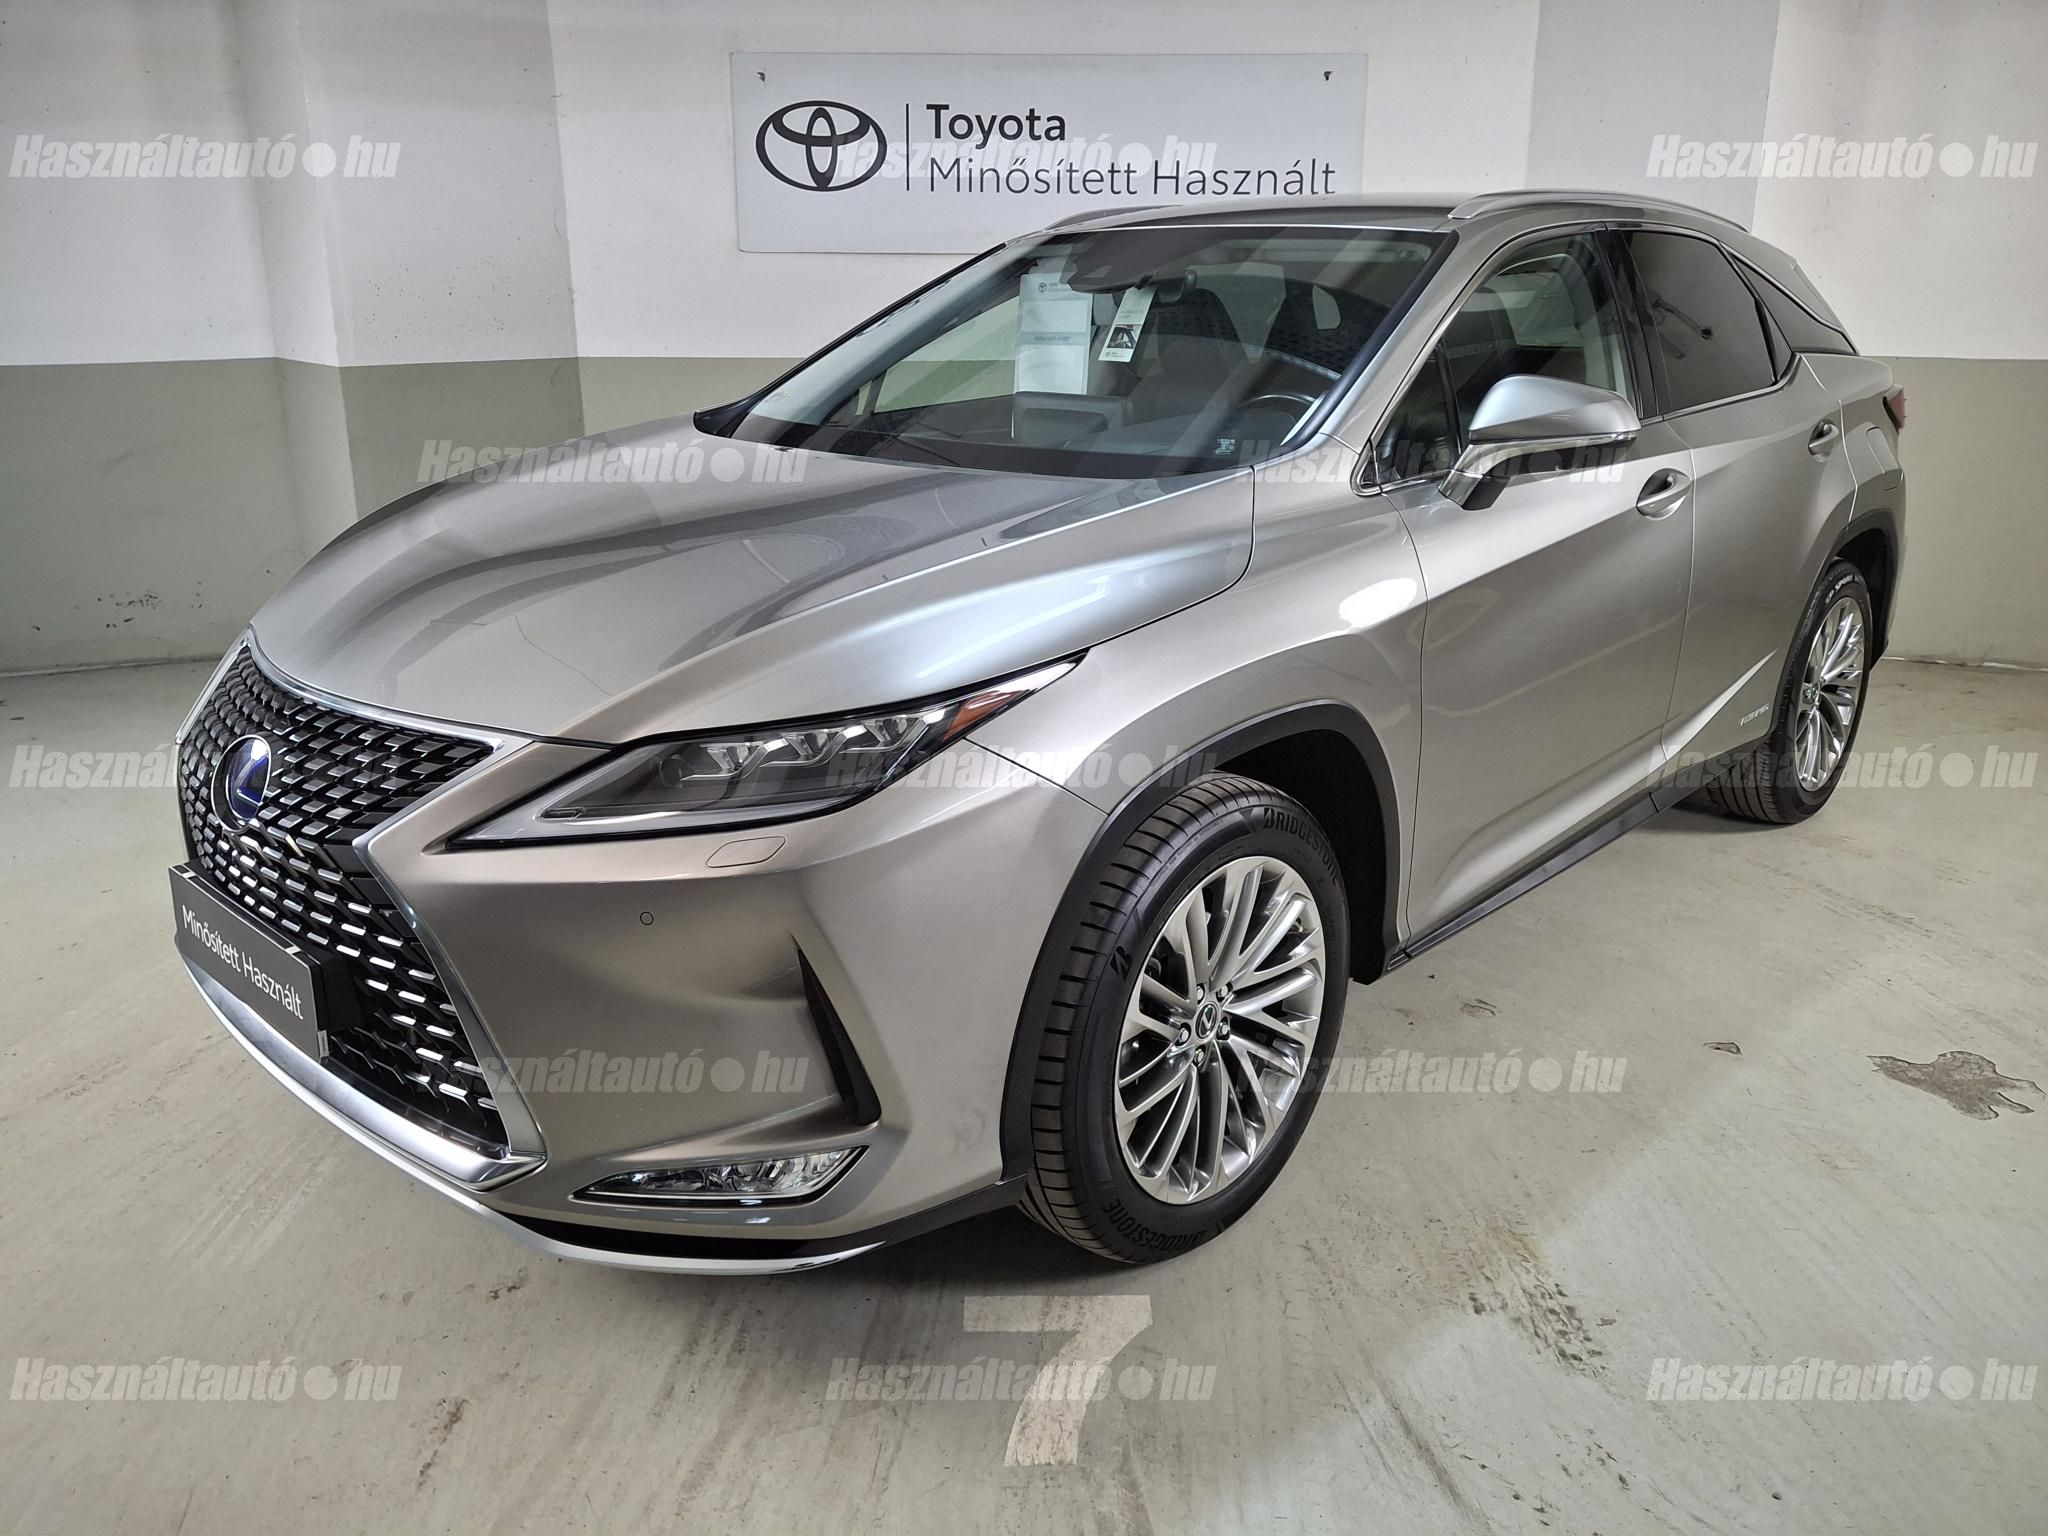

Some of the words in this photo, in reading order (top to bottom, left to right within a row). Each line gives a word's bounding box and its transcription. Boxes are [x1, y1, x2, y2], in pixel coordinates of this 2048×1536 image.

[926, 103, 1066, 149] Toyota
[929, 156, 1137, 194] Minősített
[1153, 158, 1335, 196] Használt
[1263, 807, 1339, 887] BRIDGESTONE
[182, 904, 242, 973] Minősített
[242, 952, 303, 1020] Használt
[963, 1294, 1153, 1467] 7
